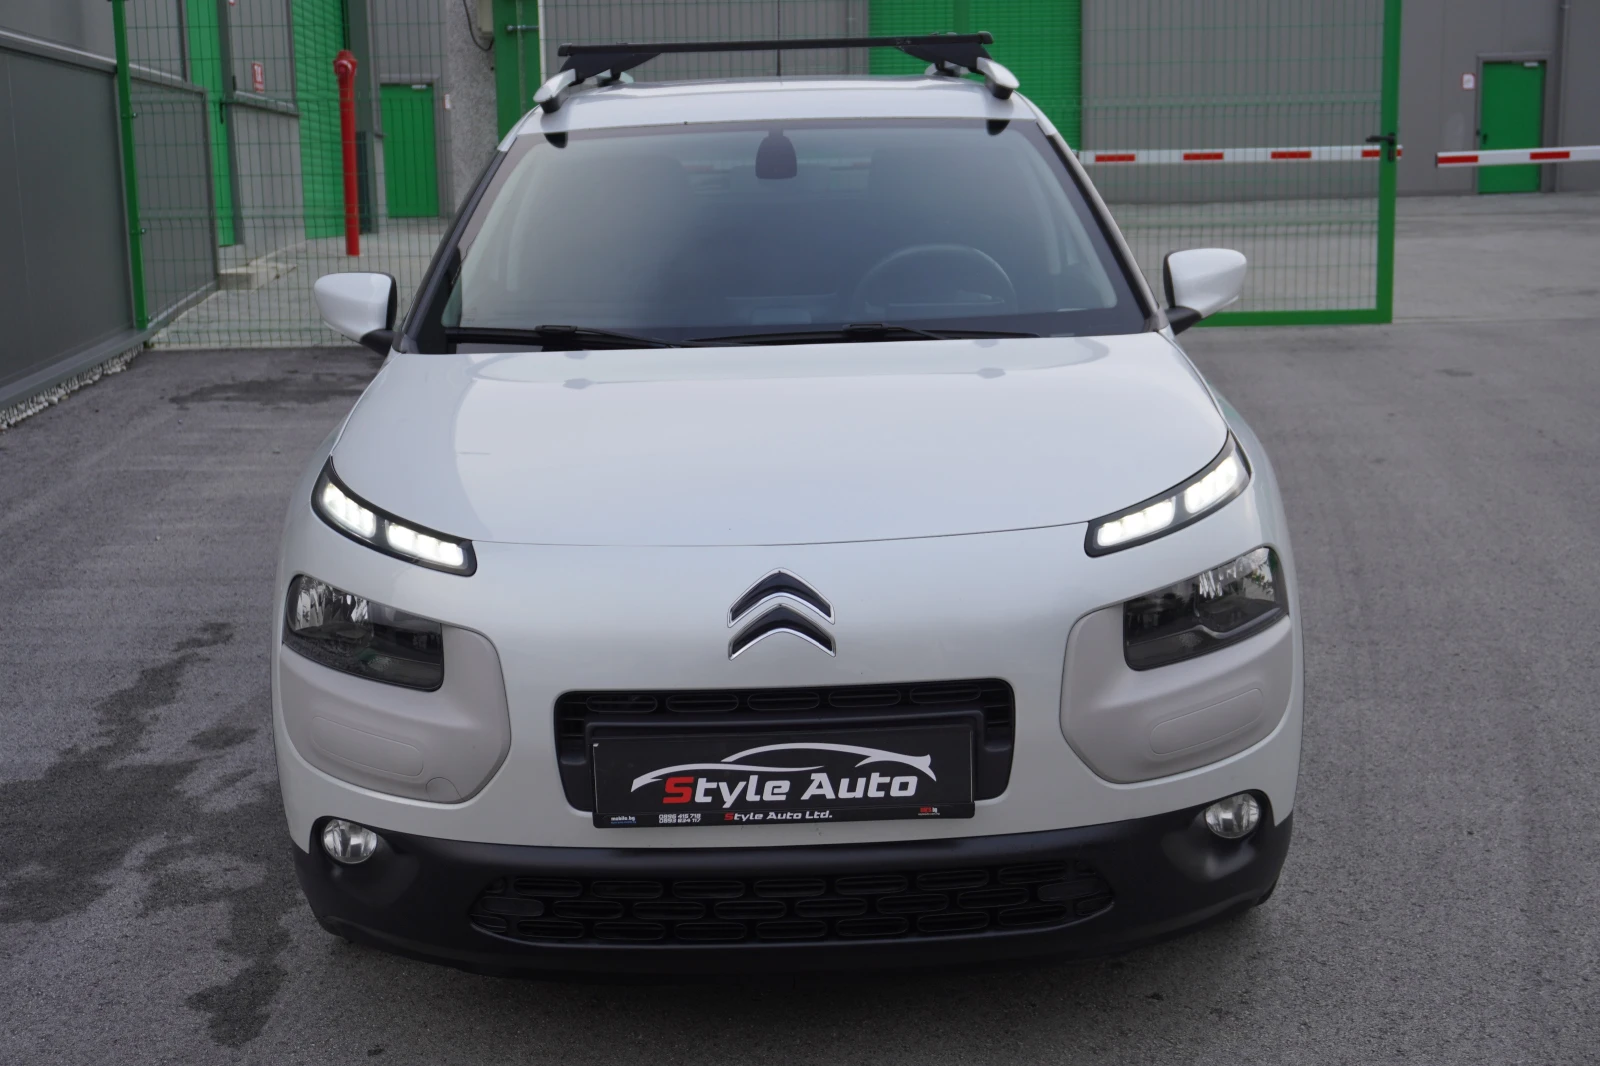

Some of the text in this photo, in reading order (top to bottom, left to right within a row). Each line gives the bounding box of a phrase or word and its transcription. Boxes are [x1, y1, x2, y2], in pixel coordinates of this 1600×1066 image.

[662, 772, 919, 808] Style Auto
[724, 810, 833, 821] Style Auto Ltd.
